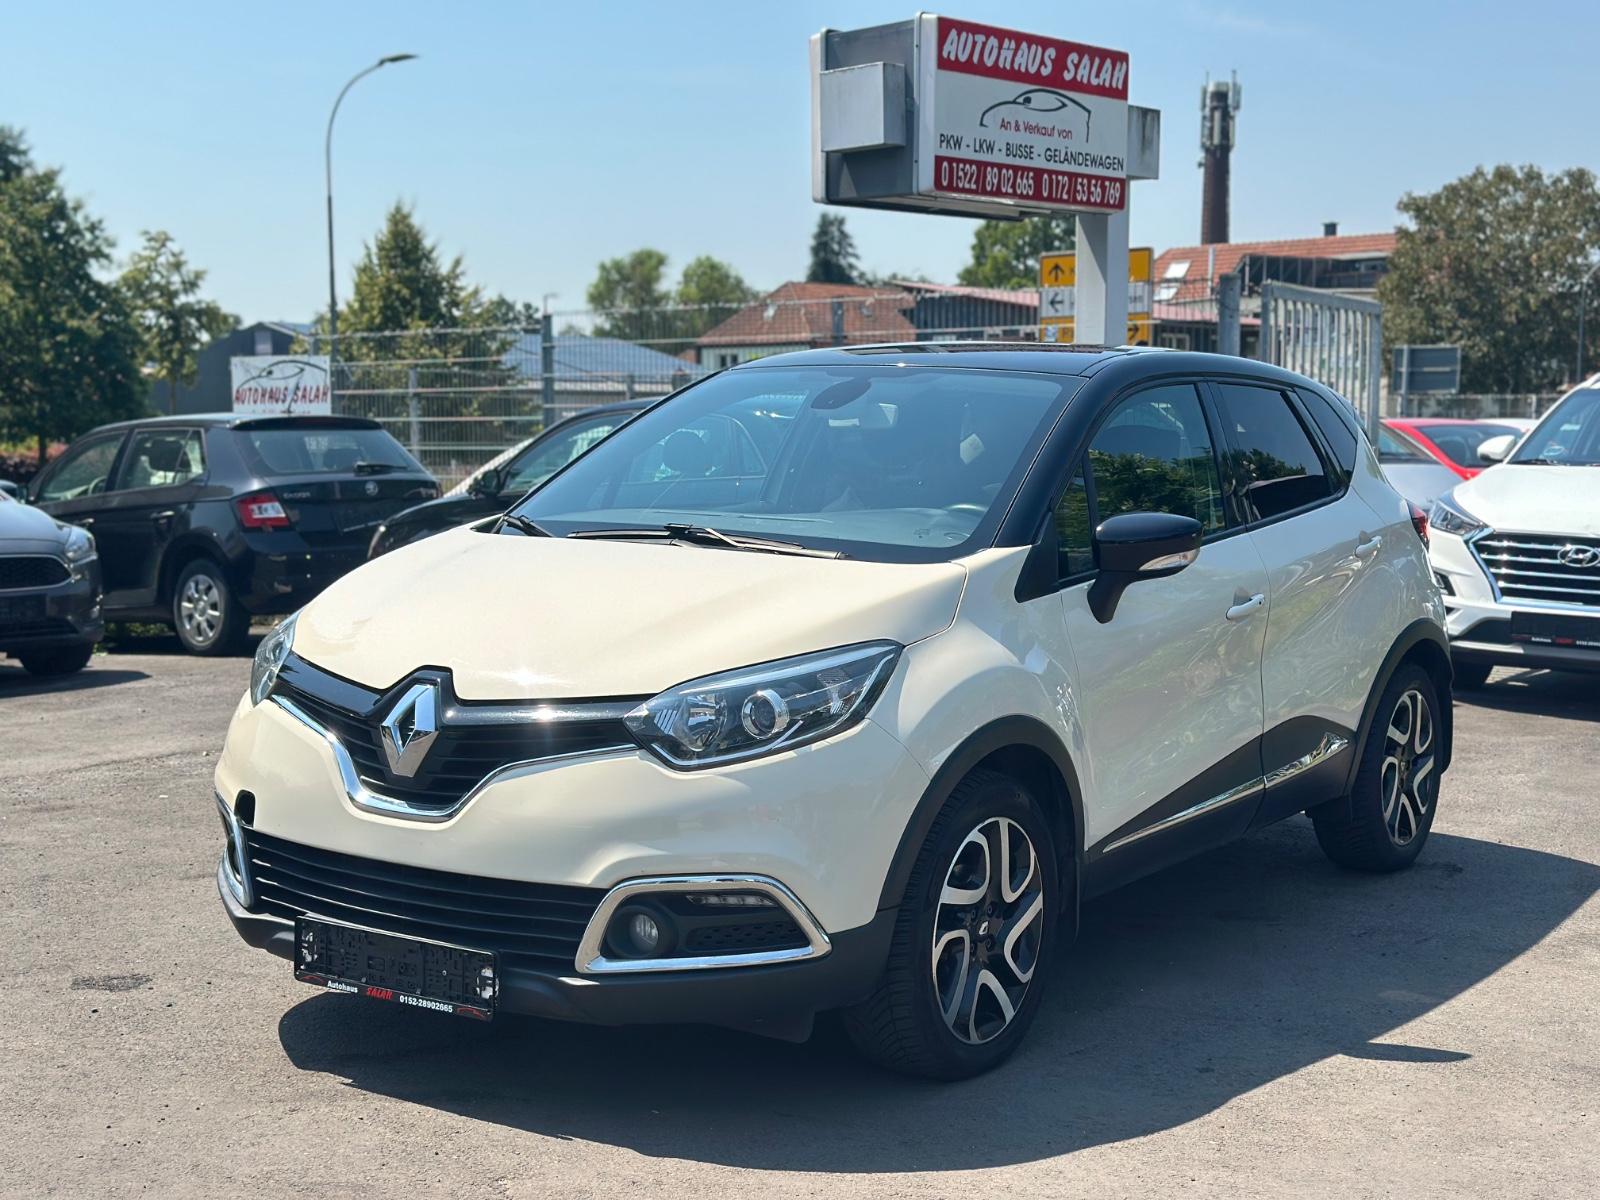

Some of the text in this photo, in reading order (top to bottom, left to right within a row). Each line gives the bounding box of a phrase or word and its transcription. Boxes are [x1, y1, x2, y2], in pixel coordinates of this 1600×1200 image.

[942, 28, 1127, 90] AUTOHAUS SALAH
[1000, 117, 1073, 140] An & Verkauf von
[939, 133, 963, 151] PKW
[973, 138, 996, 155] LKW
[1005, 142, 1035, 160] BUSSE
[1044, 146, 1124, 172] GELÄNDEWAGEN
[941, 161, 949, 187] 0
[952, 162, 977, 190] 1522
[985, 166, 999, 192] 89
[1000, 168, 1014, 194] 02
[1015, 170, 1034, 196] 665
[1042, 173, 1049, 198] 0
[1051, 174, 1069, 200] 172
[1076, 178, 1088, 202] 53
[1090, 179, 1102, 204] 56
[1104, 181, 1121, 206] 769
[235, 384, 329, 405] AUTOHAUS SALAH
[327, 980, 453, 1013] Autohaus SALAH 0152-28902665
